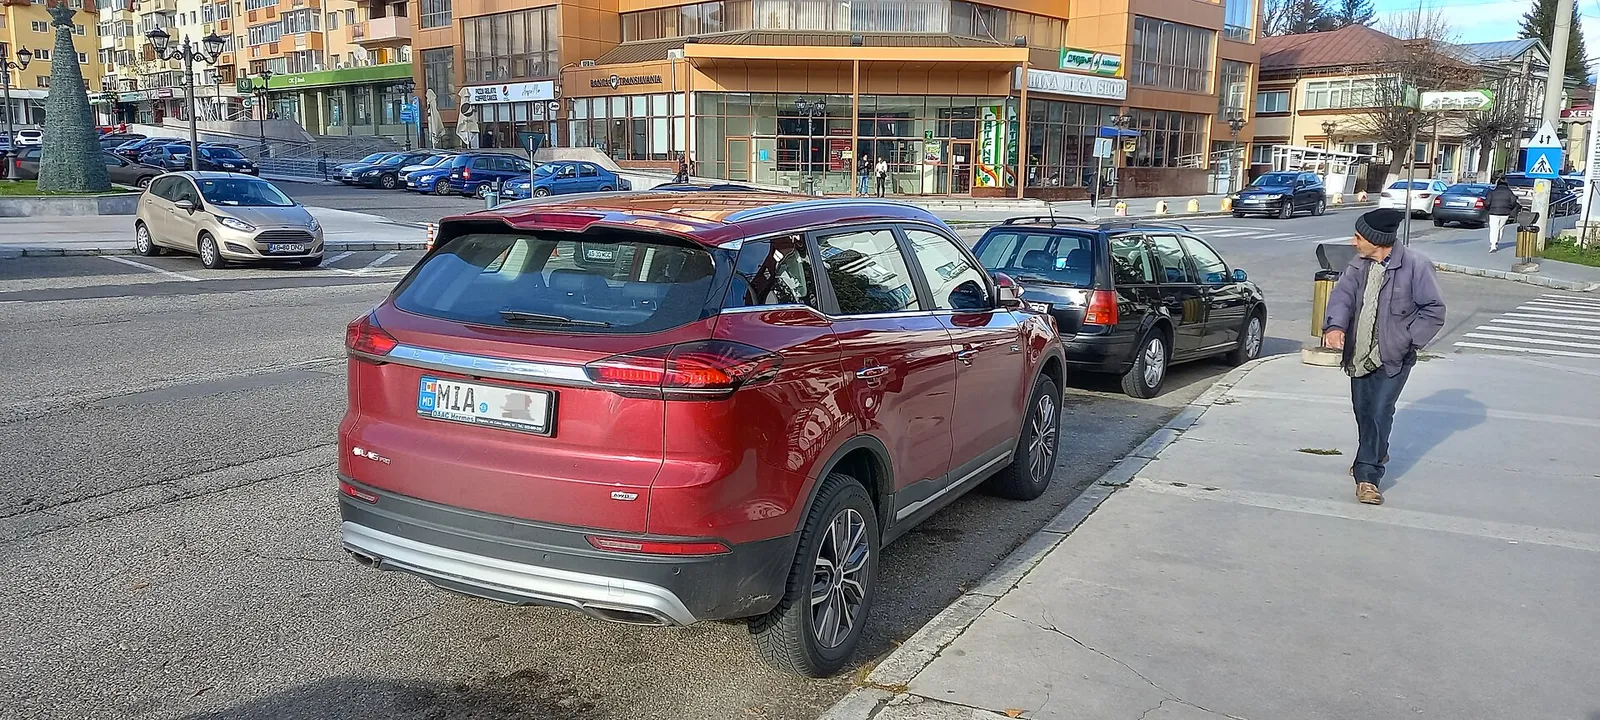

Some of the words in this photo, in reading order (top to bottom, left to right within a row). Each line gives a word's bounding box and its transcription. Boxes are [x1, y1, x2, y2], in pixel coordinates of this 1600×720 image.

[619, 75, 663, 87] TRANSILVANIA
[1026, 71, 1059, 91] HINA
[1063, 75, 1092, 93] MEGA
[1096, 80, 1125, 98] SHOP
[1569, 109, 1594, 118] XER
[982, 114, 993, 165] CATENA
[421, 396, 434, 408] MD
[436, 383, 476, 413] MIA
[450, 412, 475, 423] Hermes
